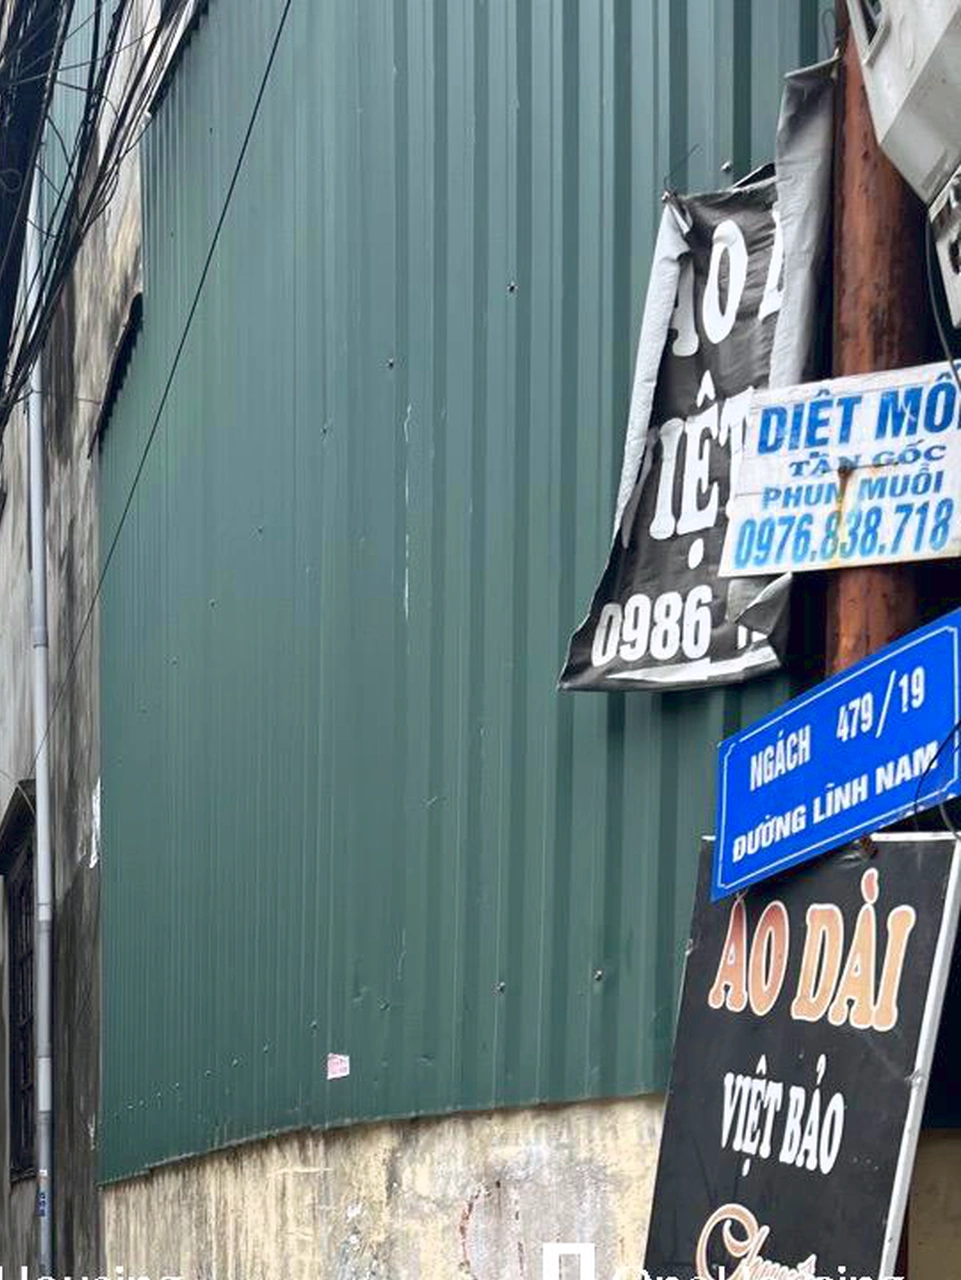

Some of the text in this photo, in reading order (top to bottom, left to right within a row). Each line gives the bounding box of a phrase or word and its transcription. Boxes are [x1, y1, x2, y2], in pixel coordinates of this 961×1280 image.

[758, 389, 862, 458] DIỆT
[872, 439, 947, 467] GỐC
[735, 498, 955, 570] 0976.838.718
[750, 724, 811, 791] NGÁCH
[732, 740, 939, 863] ĐƯỜNG LĨNH NAM
[791, 867, 916, 1032] DÀI
[721, 1054, 845, 1177] VIỆT BẢO
